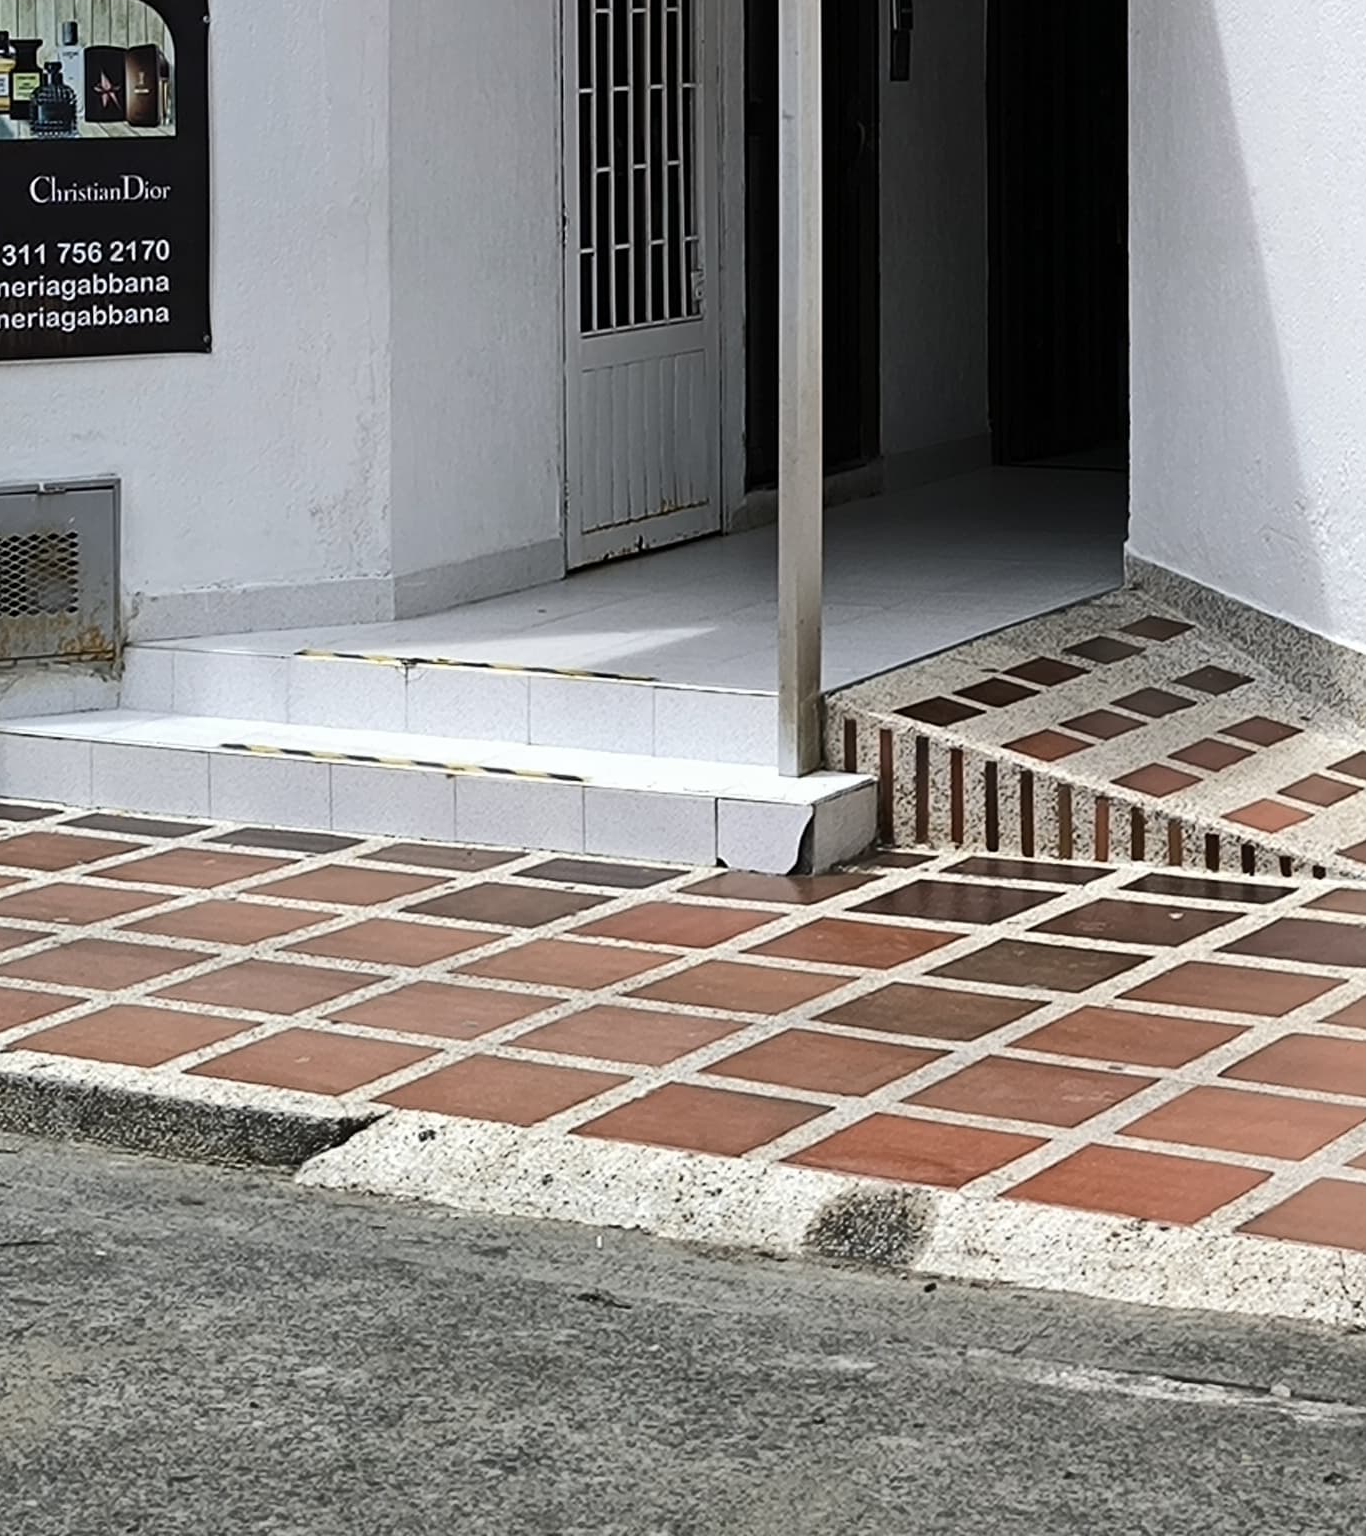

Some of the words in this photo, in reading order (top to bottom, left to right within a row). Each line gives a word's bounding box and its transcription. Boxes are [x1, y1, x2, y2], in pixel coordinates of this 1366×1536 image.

[1, 243, 47, 267] 311
[57, 241, 102, 265] 756
[109, 239, 170, 263] 2170
